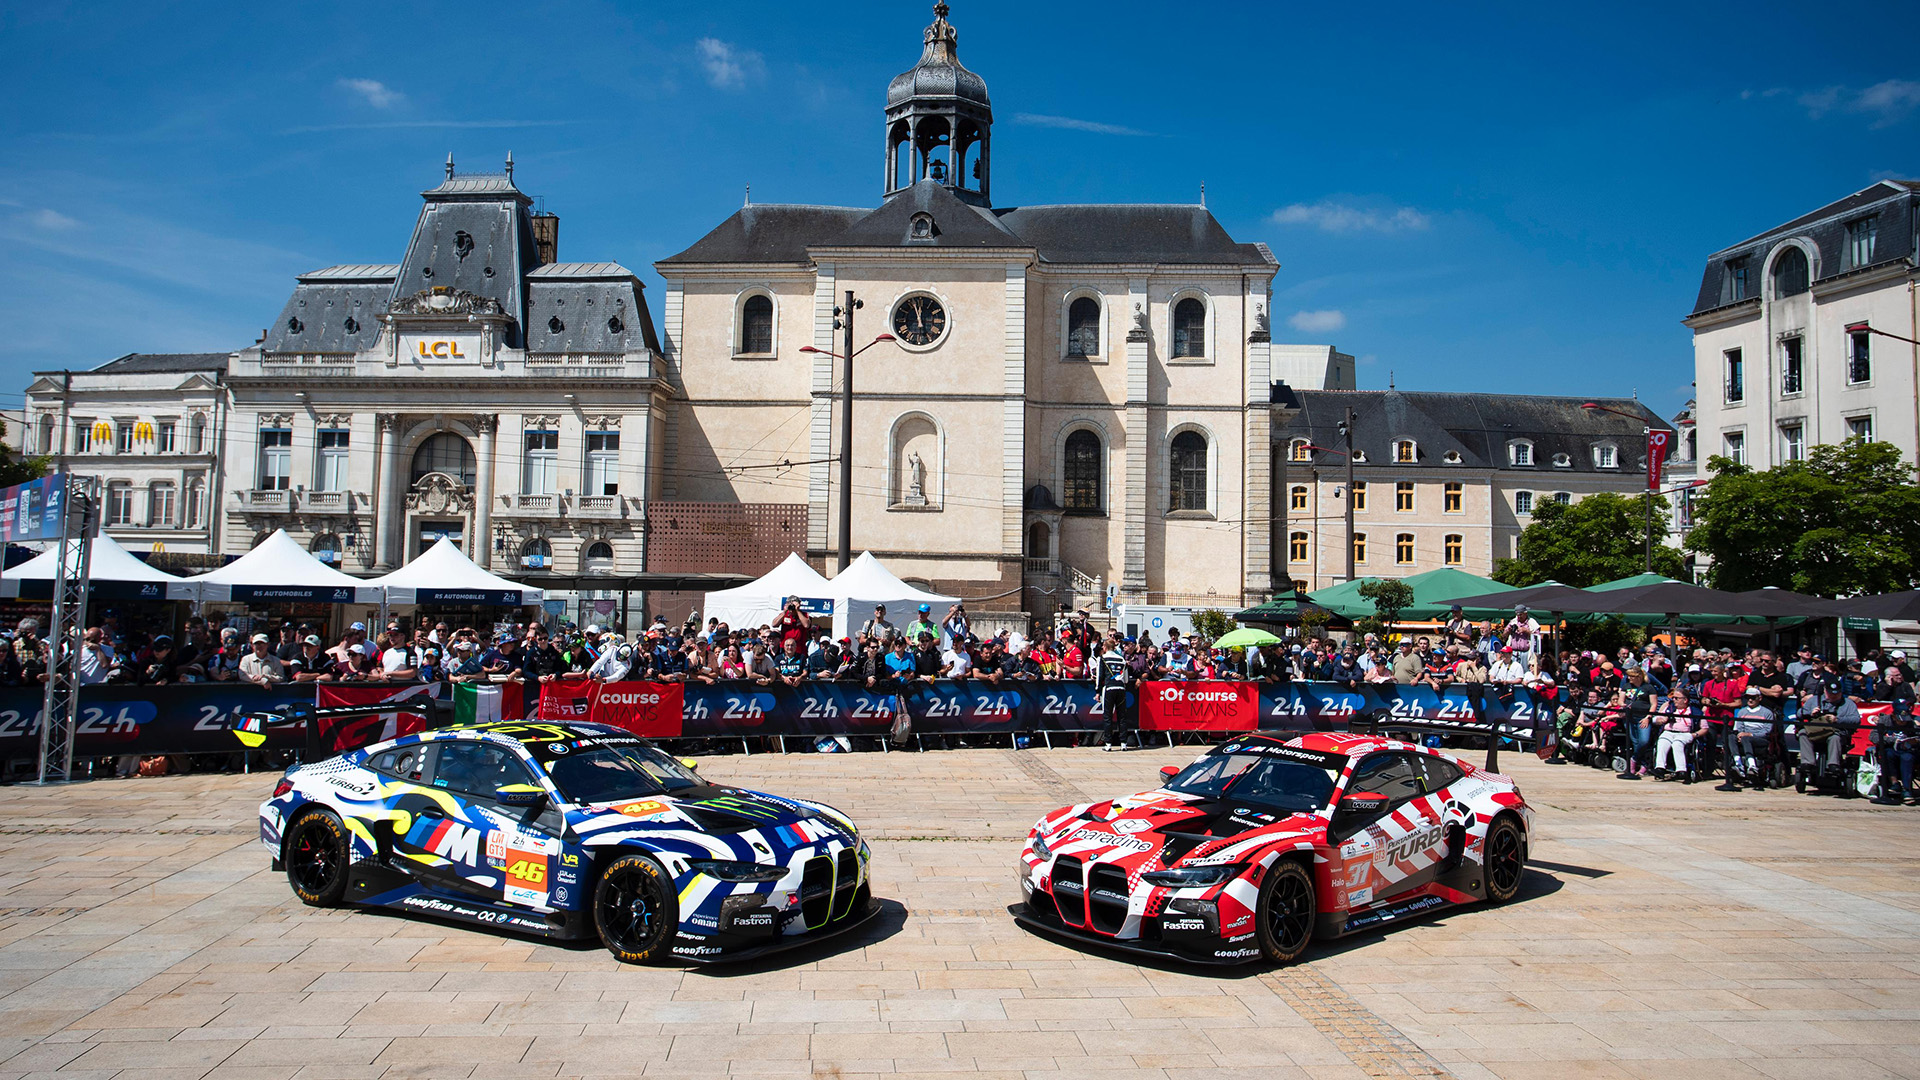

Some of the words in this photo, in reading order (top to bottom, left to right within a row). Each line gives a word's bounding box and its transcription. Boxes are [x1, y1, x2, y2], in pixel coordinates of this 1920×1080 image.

[419, 341, 464, 357] LCL
[600, 693, 660, 704] course
[1188, 691, 1238, 701] course
[723, 697, 762, 720] 24h
[800, 697, 838, 719] 24h
[852, 697, 892, 720] 24h
[926, 695, 961, 718] 24h
[974, 695, 1009, 716] 24h
[1042, 695, 1078, 715] 24h
[1164, 702, 1182, 716] LE
[1190, 702, 1238, 717] MANS
[1271, 696, 1306, 717] 24h
[1319, 697, 1354, 717] 24h
[1390, 698, 1424, 718] 24h
[1438, 699, 1475, 719] 24h
[76, 706, 136, 734] 24h
[603, 706, 658, 722] MANS
[1266, 746, 1326, 763] Motorsport
[325, 777, 363, 793] TURBO
[623, 801, 661, 814] 46
[1229, 815, 1264, 828] Motorsport
[491, 832, 505, 844] LM
[1071, 829, 1152, 851] paradine
[1388, 829, 1422, 849] PERTAMAX
[489, 843, 504, 856] GT3
[508, 860, 547, 884] 46
[603, 858, 659, 880] GOODYEAR
[1345, 861, 1371, 888] 31
[1332, 879, 1344, 887] Halo
[513, 889, 538, 899] WEC
[403, 897, 454, 912] GOODYEAR
[478, 911, 496, 922] OQ
[520, 919, 549, 930] Motorsport
[691, 918, 717, 928] oman
[734, 918, 772, 926] Fastron
[1163, 922, 1205, 930] Fastron
[620, 950, 650, 960] EAGLE
[672, 946, 722, 956] GOODYEAR
[1214, 948, 1260, 958] GOODYEAR
